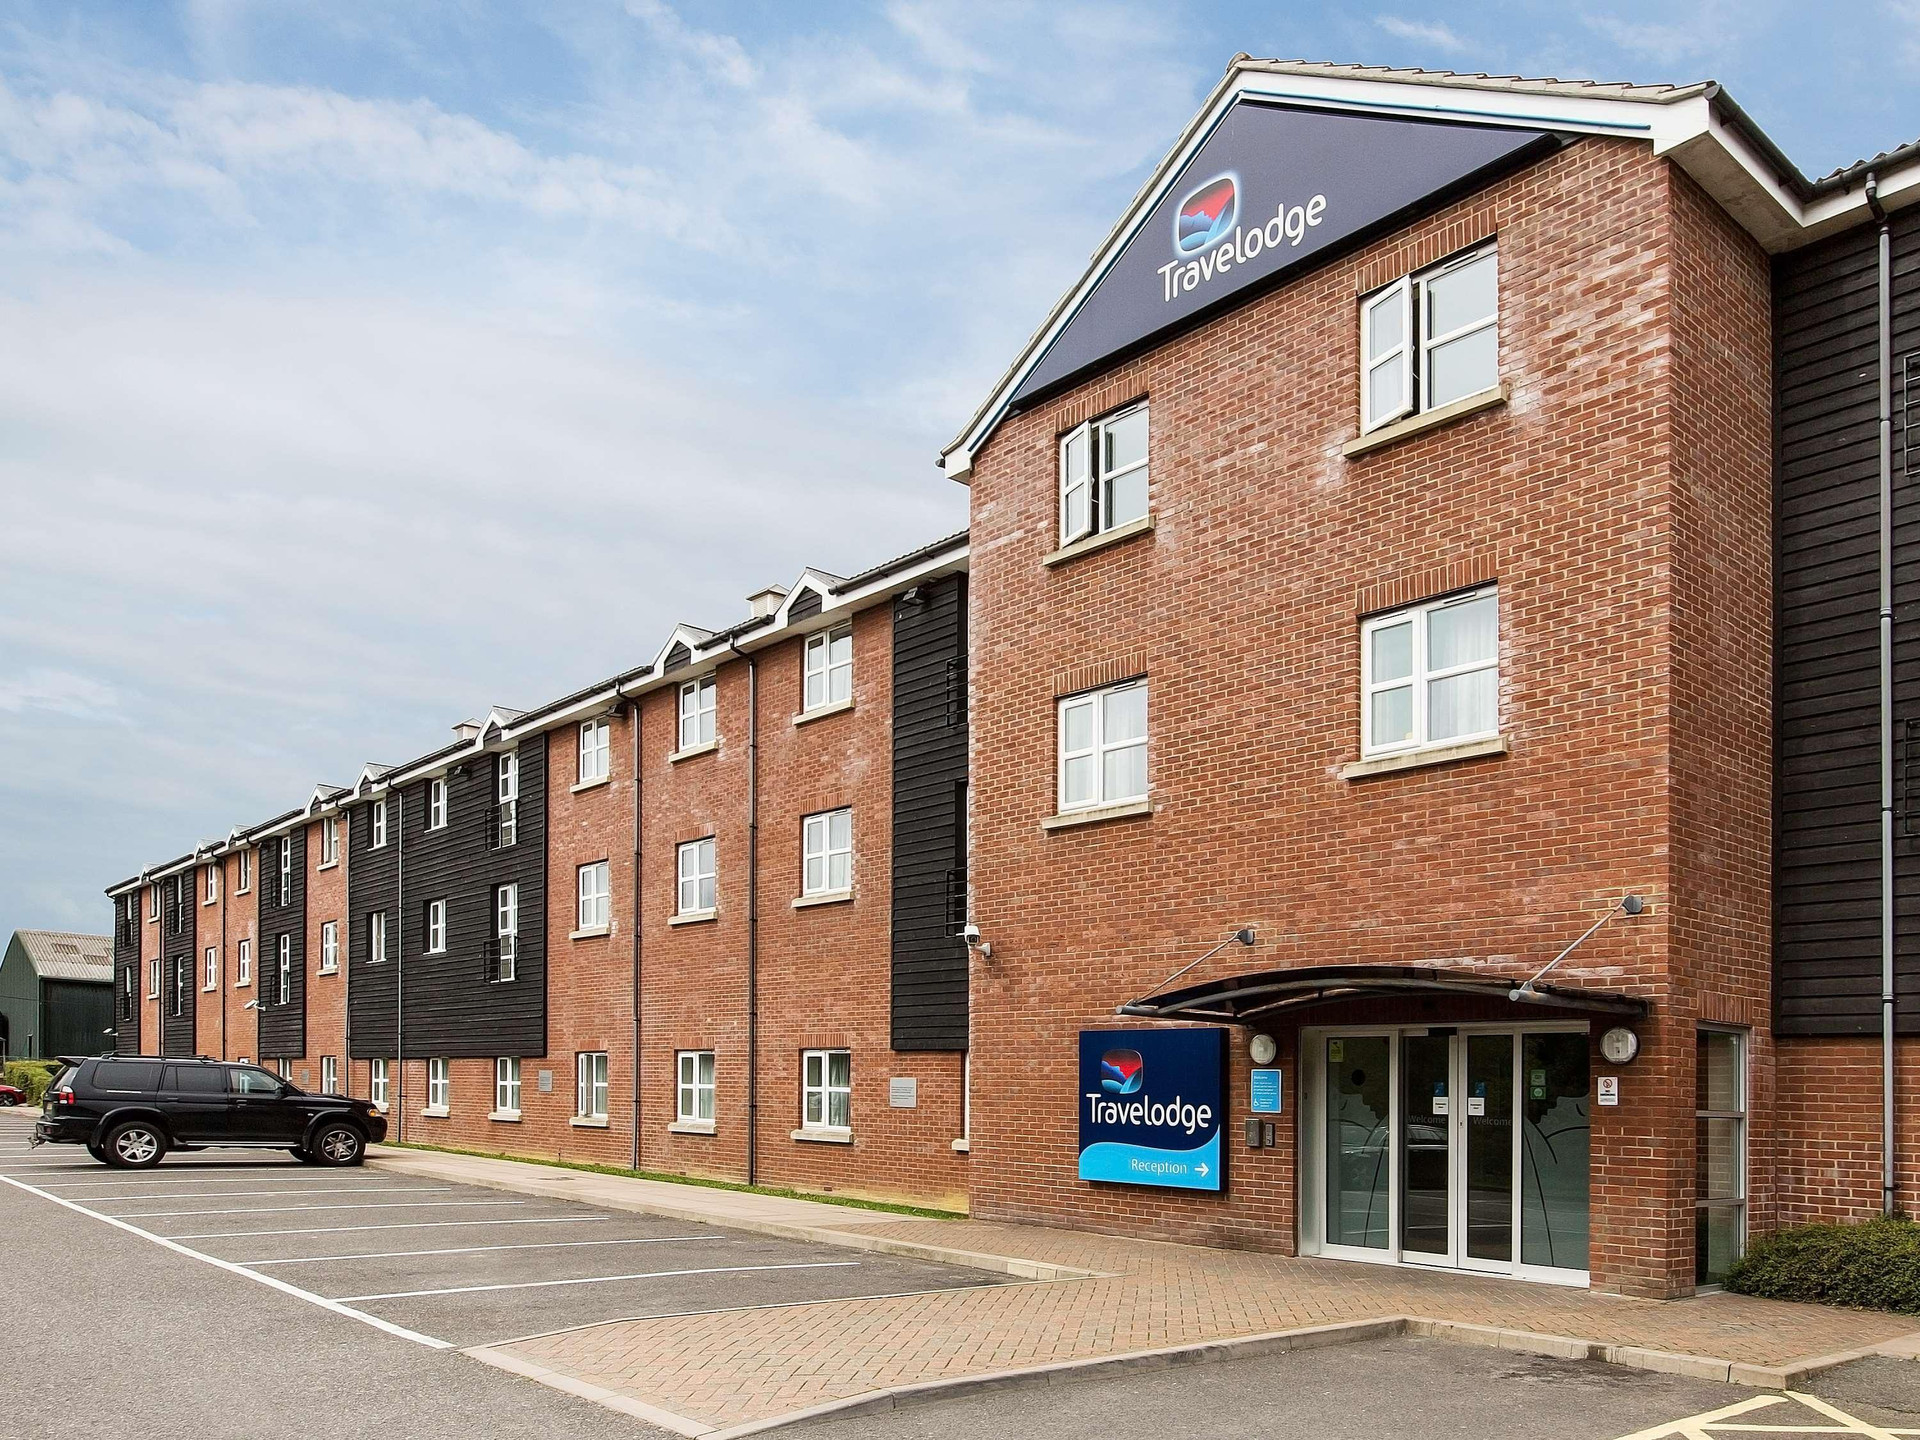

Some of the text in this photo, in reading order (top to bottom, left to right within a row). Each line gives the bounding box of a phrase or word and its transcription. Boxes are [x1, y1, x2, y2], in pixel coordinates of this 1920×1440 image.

[1157, 194, 1327, 302] Travelodge
[1086, 1093, 1212, 1135] Travelodge
[1408, 1115, 1446, 1125] Welcome
[1131, 1158, 1187, 1176] Reception
